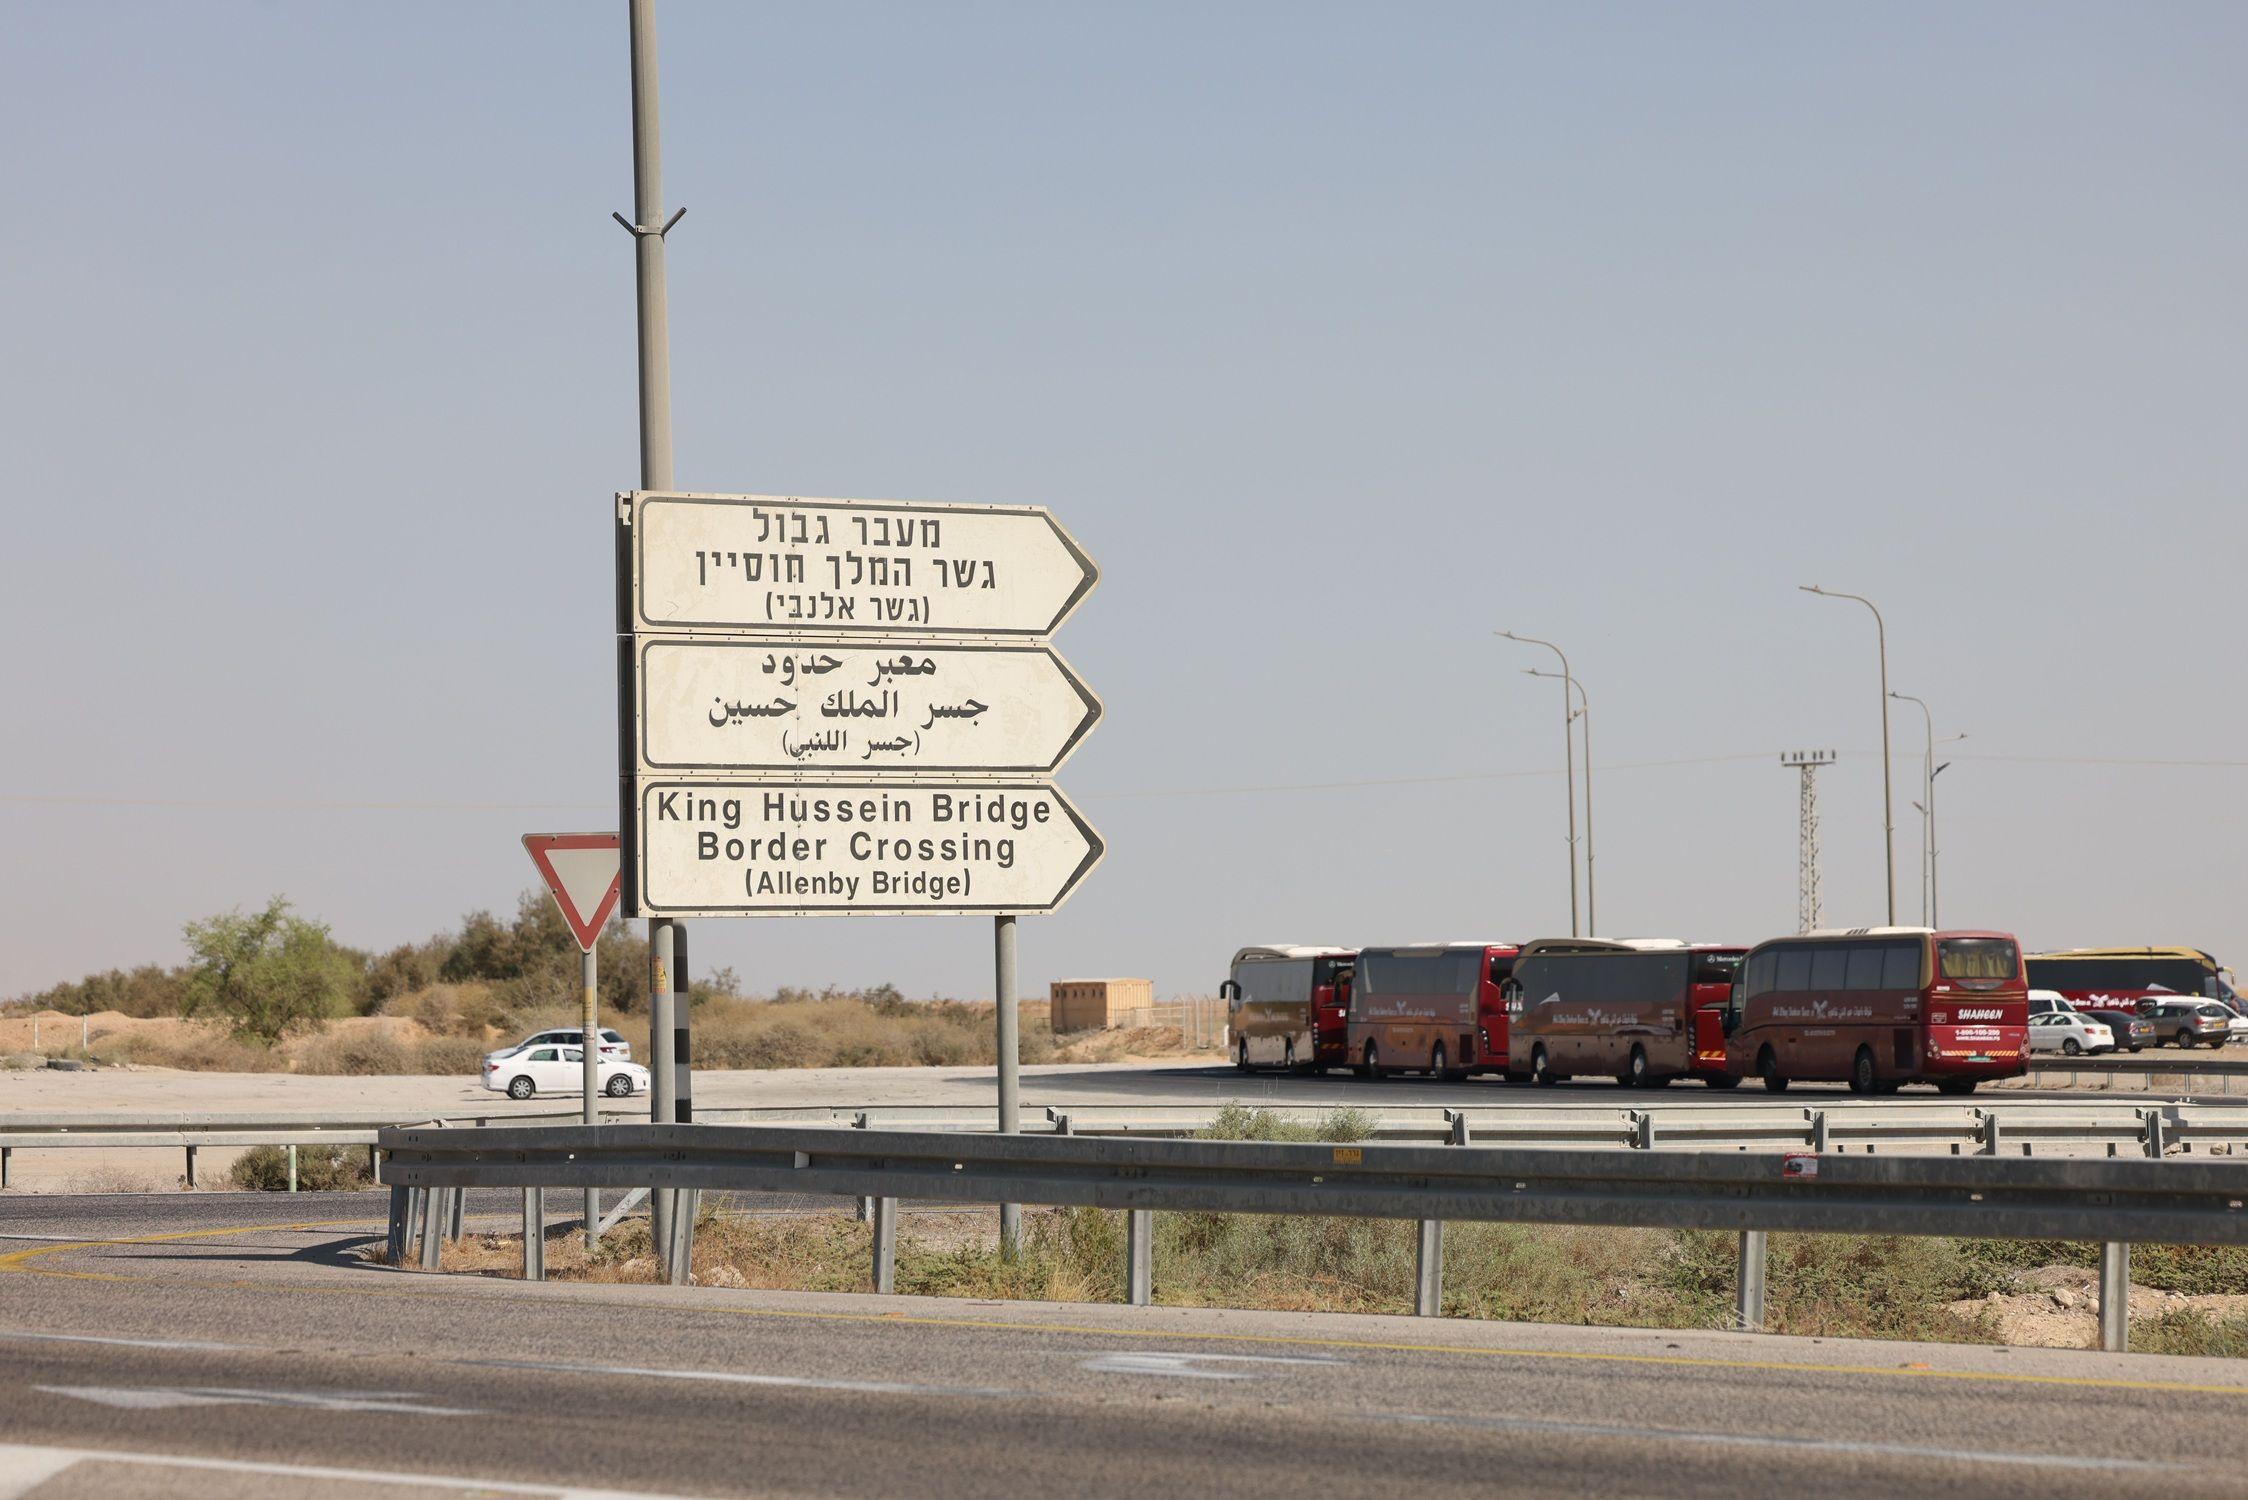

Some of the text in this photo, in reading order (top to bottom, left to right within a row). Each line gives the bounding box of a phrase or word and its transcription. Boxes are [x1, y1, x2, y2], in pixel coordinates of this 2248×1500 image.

[753, 507, 941, 548] מעבר גבול
[696, 551, 995, 589] גשר המלך חוסיין
[766, 592, 929, 624] (גשר אלנבי)
[762, 654, 936, 686] معبر حدود
[709, 690, 988, 729] جسر الملك حسين
[783, 730, 919, 761] (جسر اللنبي)
[659, 792, 1049, 830] King Hussein Bridge
[699, 832, 1013, 868] Border Crossing
[746, 868, 970, 900] (Allenby Bridge)
[1958, 1009, 2003, 1019] SHAHEEN
